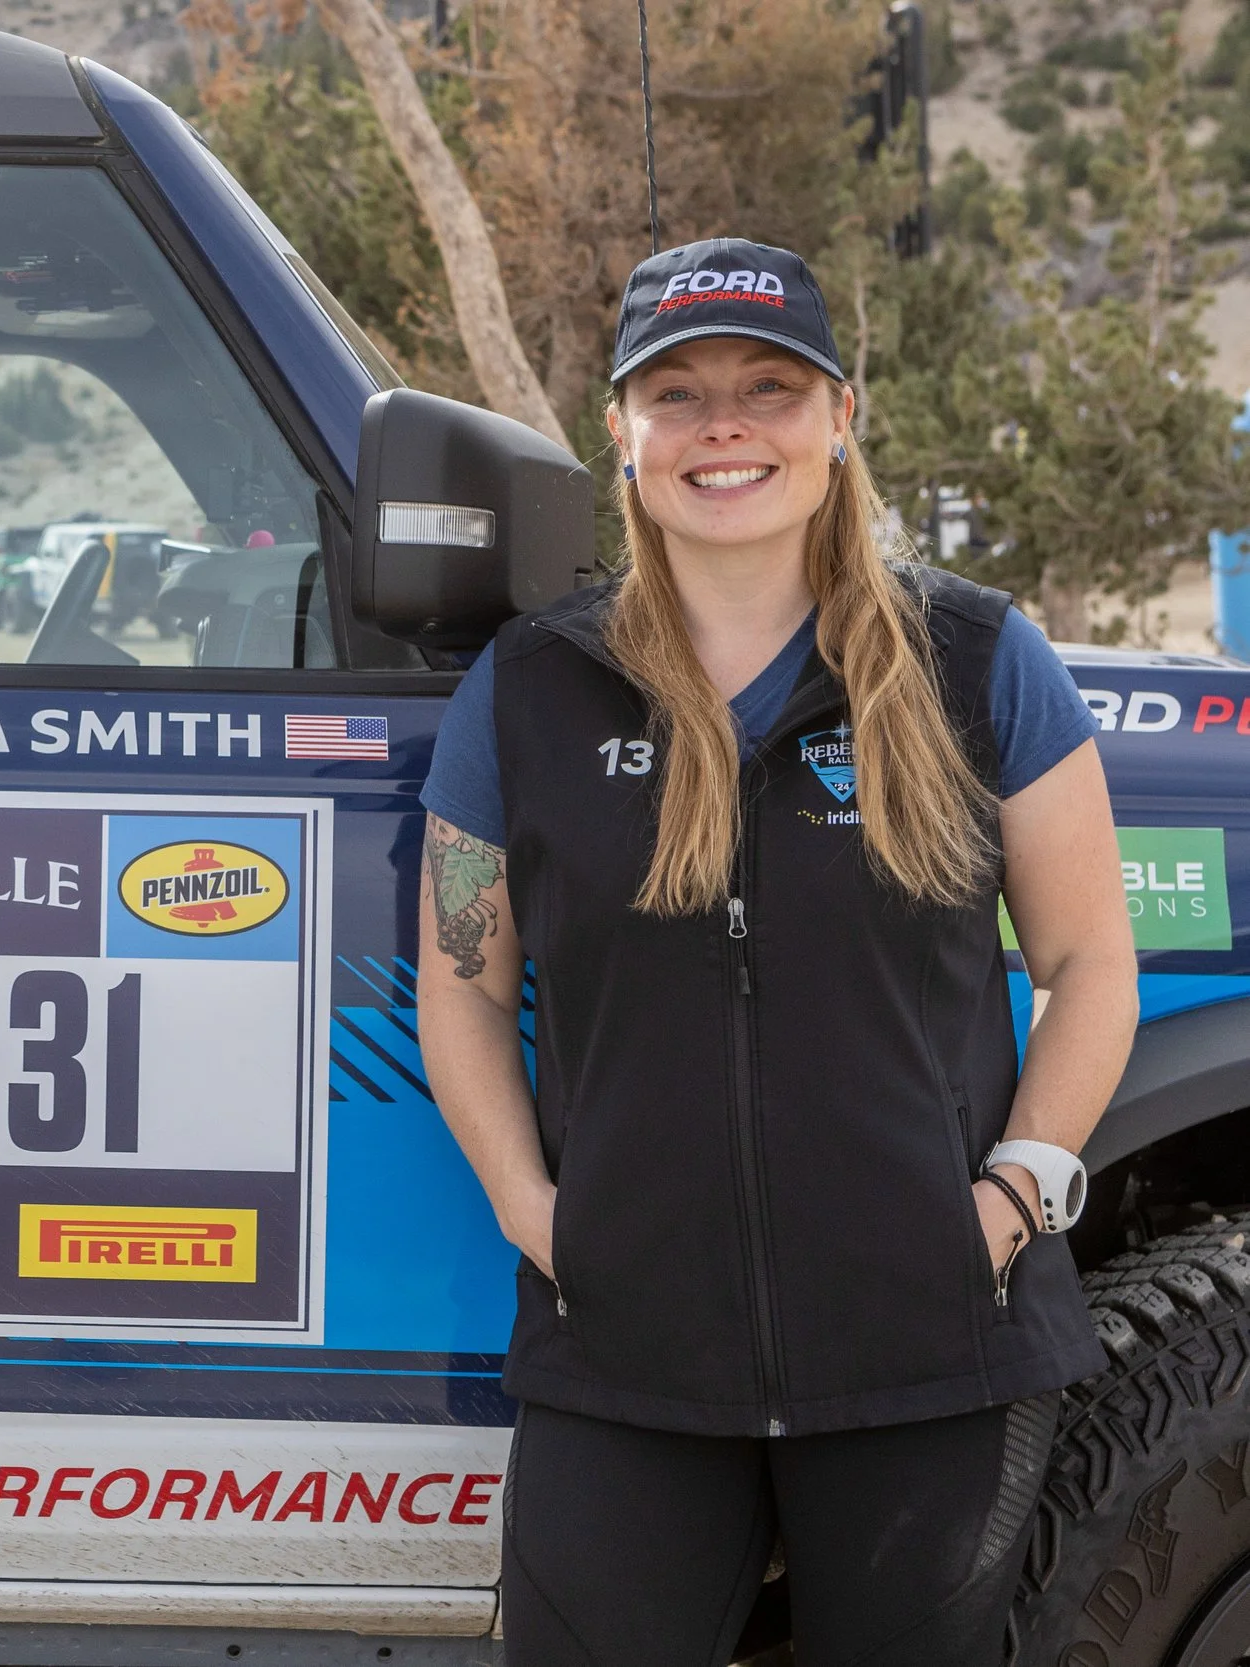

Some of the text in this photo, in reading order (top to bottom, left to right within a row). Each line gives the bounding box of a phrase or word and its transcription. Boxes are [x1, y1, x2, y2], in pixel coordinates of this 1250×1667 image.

[656, 290, 786, 316] PERFORMANCE
[661, 269, 785, 301] FORD
[30, 708, 261, 758] SMITH
[834, 783, 850, 791] '24
[142, 866, 264, 908] PENNZOIL
[39, 1219, 237, 1267] PIRELLI
